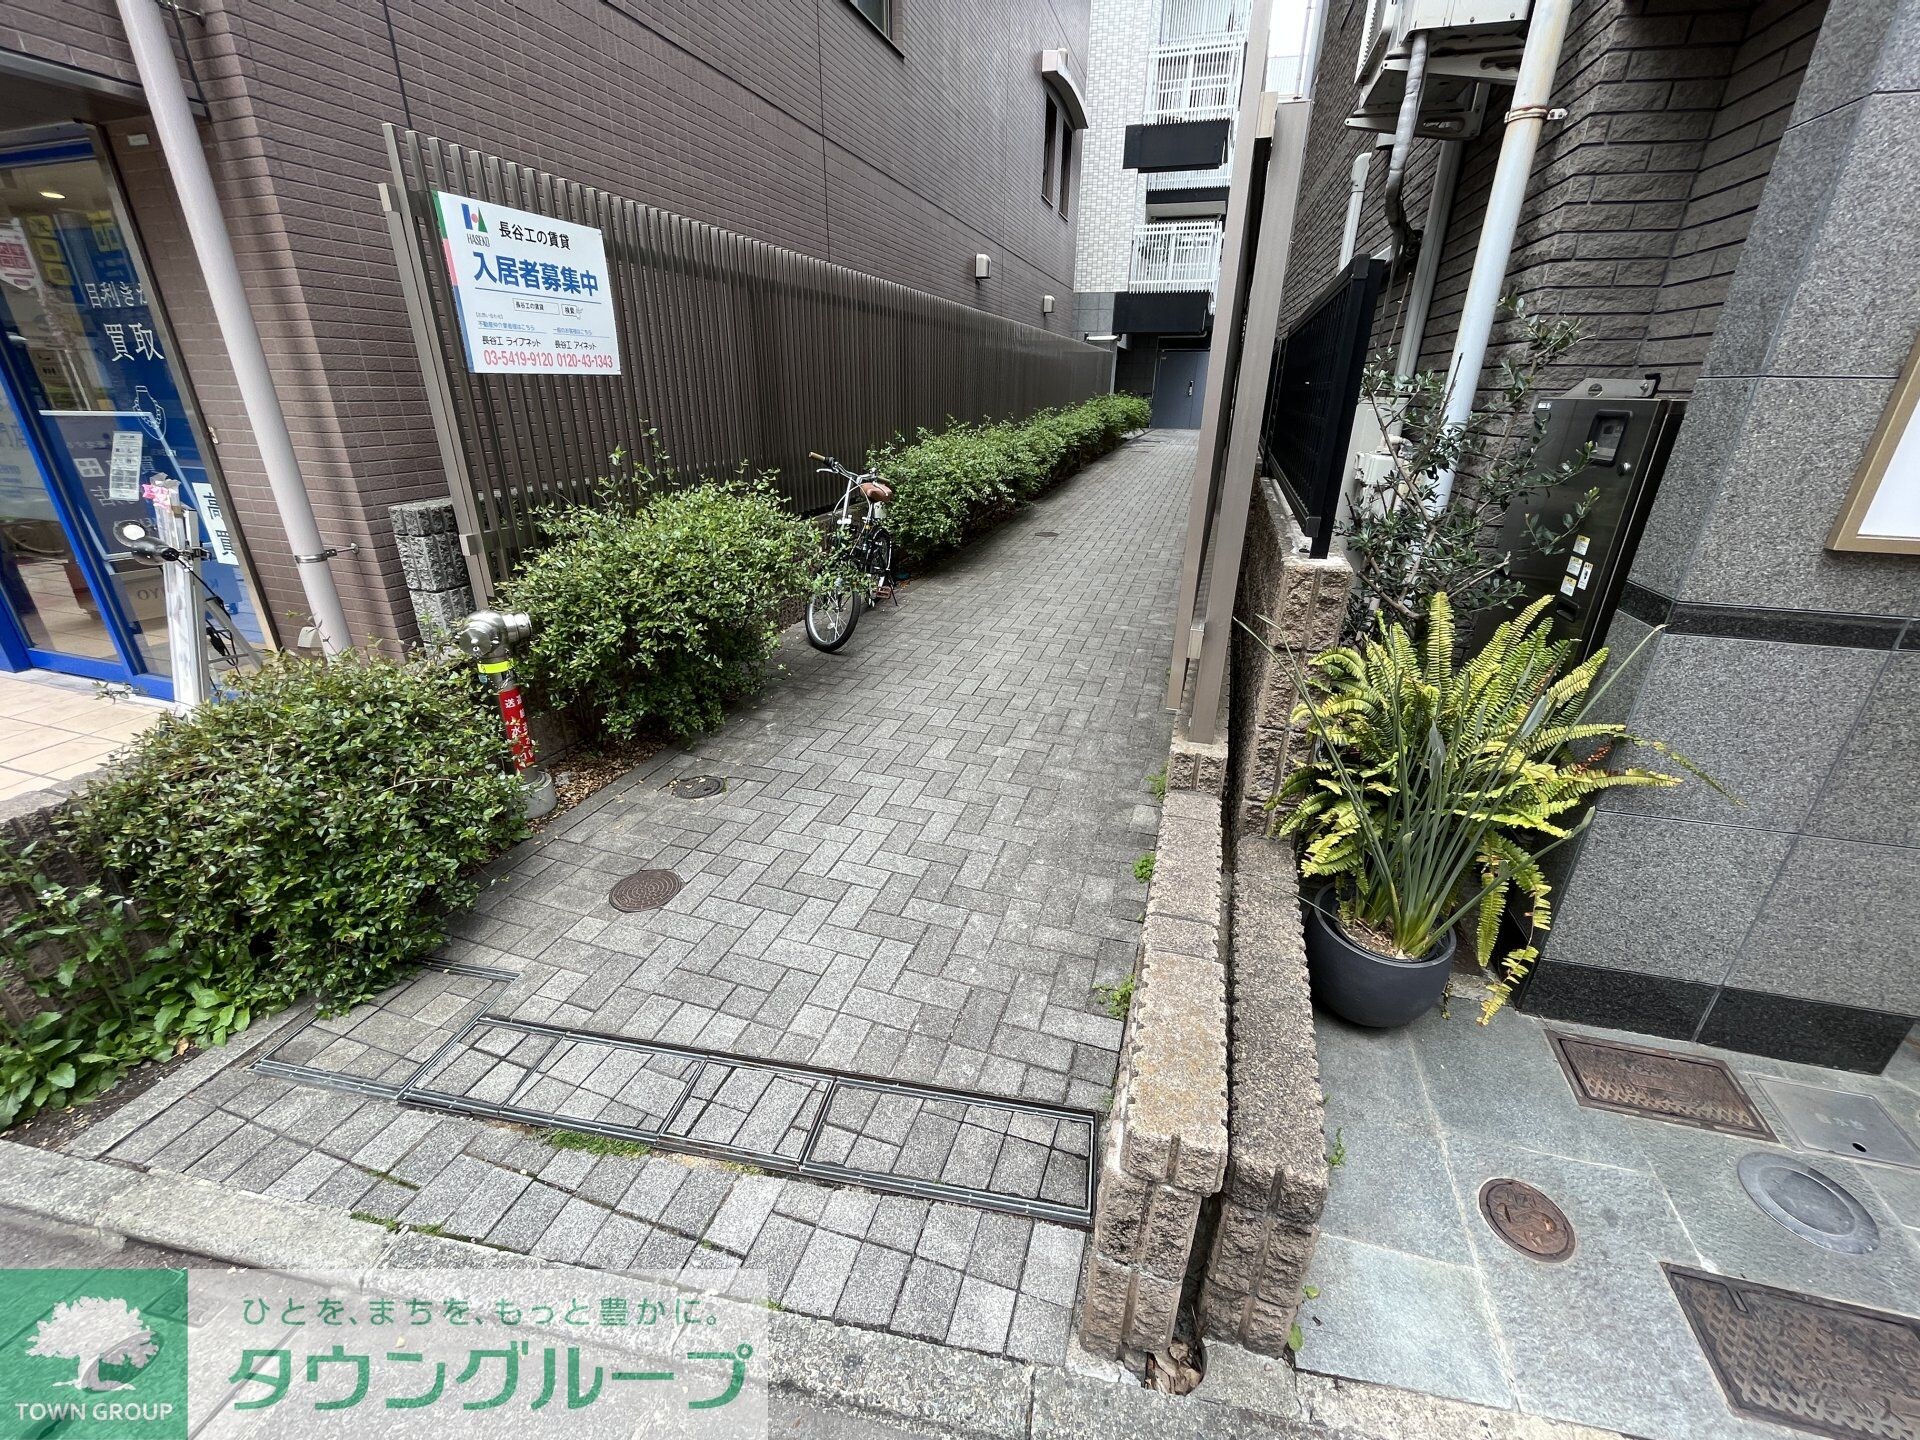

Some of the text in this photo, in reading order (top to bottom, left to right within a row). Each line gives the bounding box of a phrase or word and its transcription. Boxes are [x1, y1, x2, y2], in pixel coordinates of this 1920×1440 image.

[499, 221, 571, 251] 長谷工の賃貸
[473, 251, 599, 297] 入居者募集中
[103, 322, 166, 362] 買取
[482, 335, 504, 346] 長谷工
[555, 339, 572, 350] 長谷工
[483, 349, 554, 367] 03-5419-9120
[556, 353, 614, 369] 0120-43-1343
